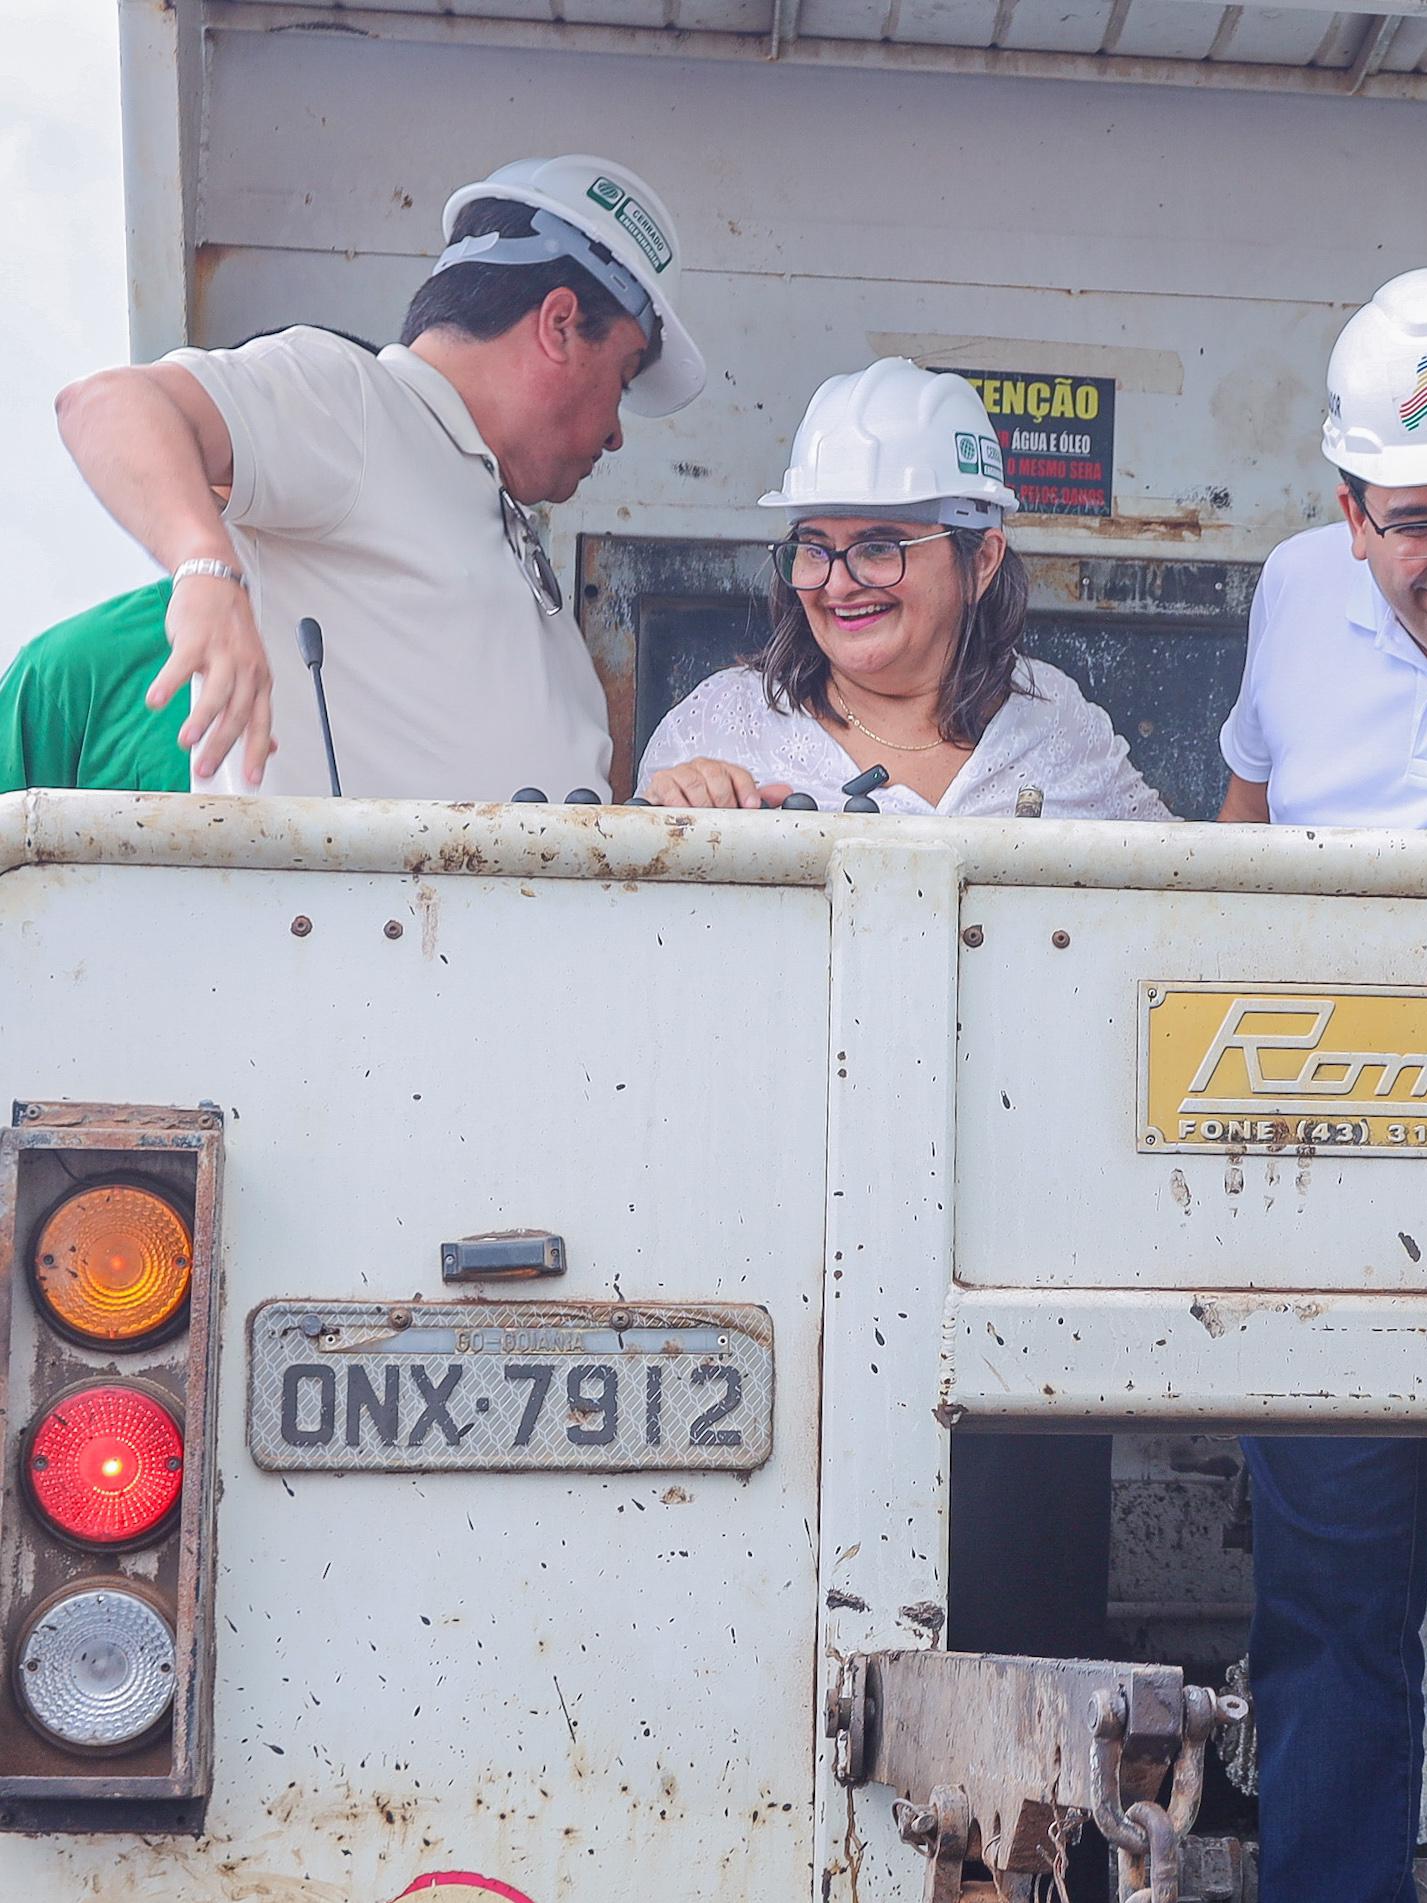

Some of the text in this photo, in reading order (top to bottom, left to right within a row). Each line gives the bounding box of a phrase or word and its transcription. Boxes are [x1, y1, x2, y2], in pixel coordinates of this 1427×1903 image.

[967, 378, 1099, 424] TENÇÃO
[1012, 427, 1047, 452] ÁGUA
[1050, 433, 1057, 451] E
[1059, 430, 1091, 454] ÓLEO
[1007, 458, 1016, 475] O
[1020, 458, 1066, 479] MESMO
[1178, 1119, 1276, 1142] FONE
[1297, 1118, 1371, 1144] (43)
